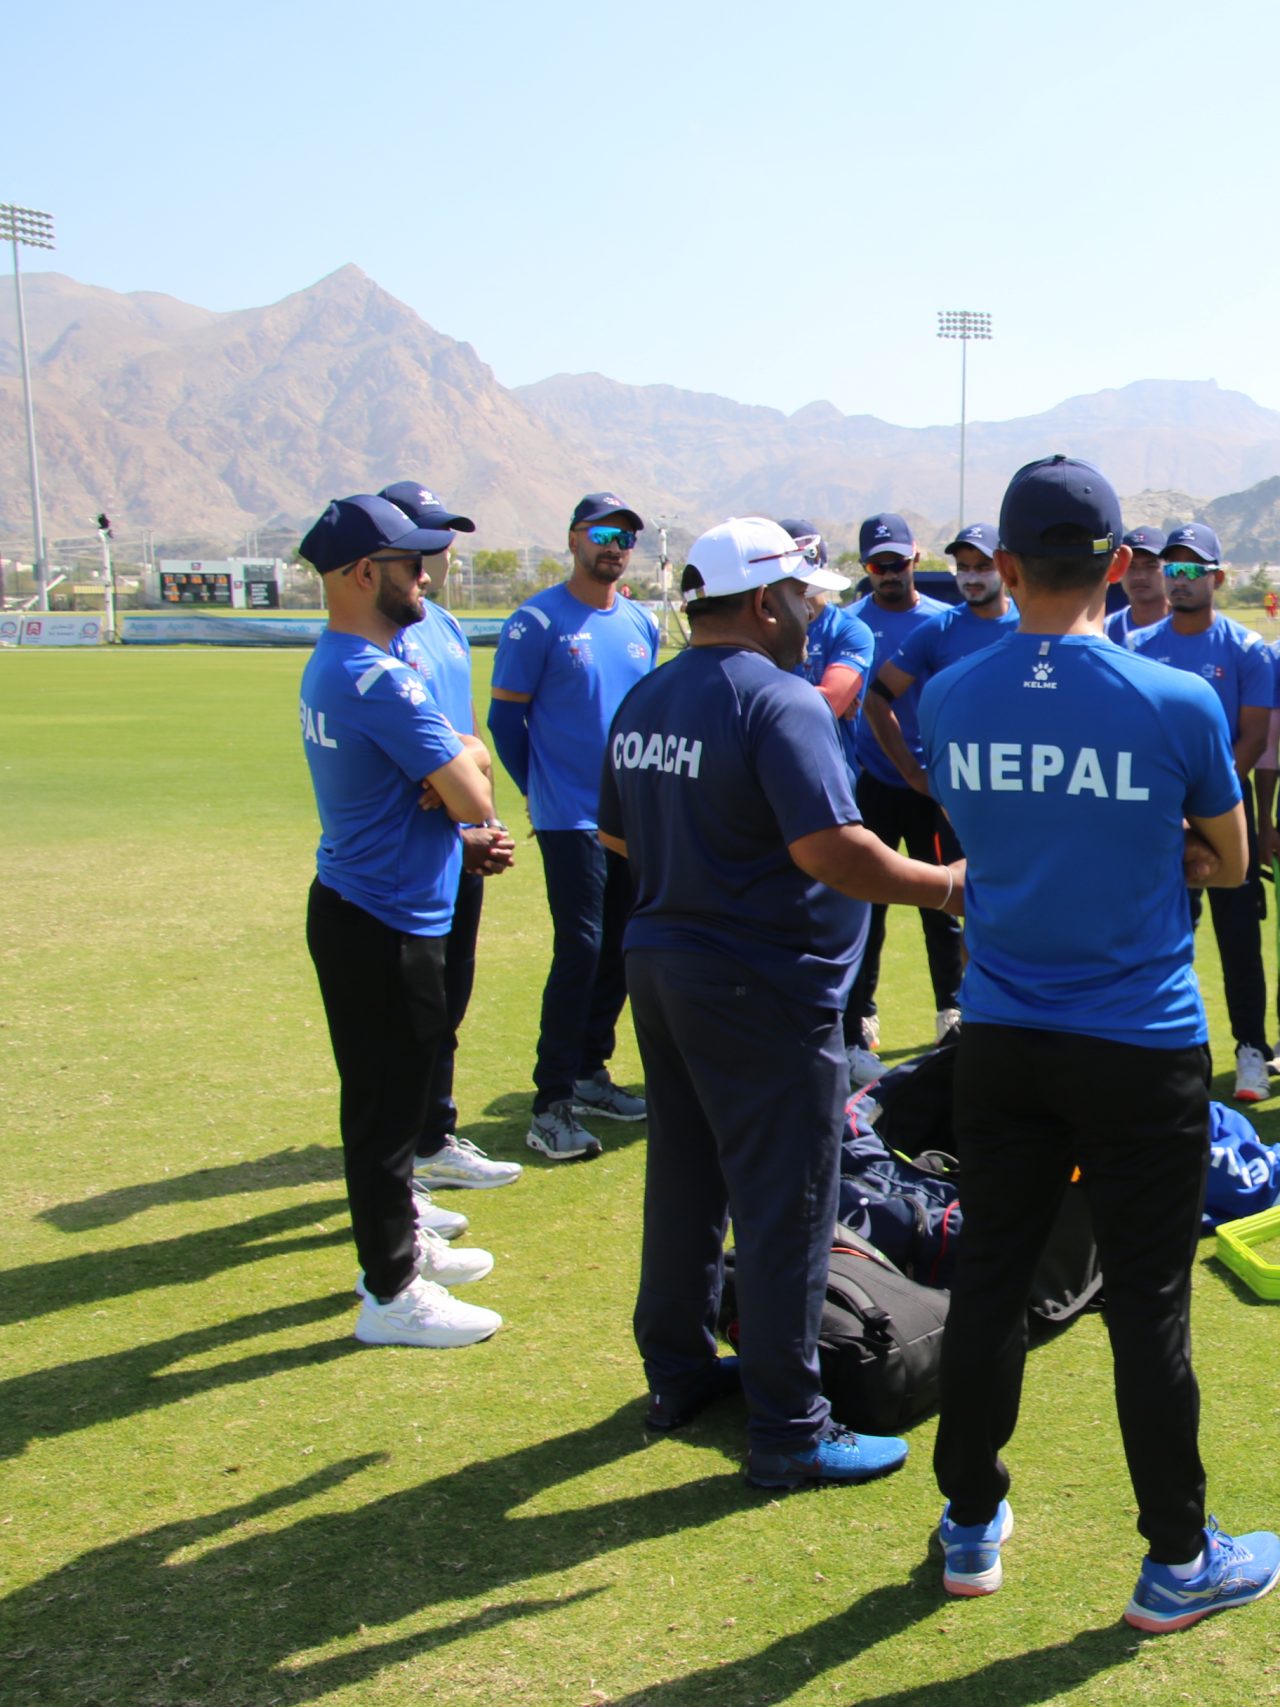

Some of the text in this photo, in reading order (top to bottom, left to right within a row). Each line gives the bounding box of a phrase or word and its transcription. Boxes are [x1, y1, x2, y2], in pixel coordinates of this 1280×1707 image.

[1023, 680, 1058, 689] KELME
[612, 731, 703, 779] COACH
[948, 742, 1150, 801] NEPAL
